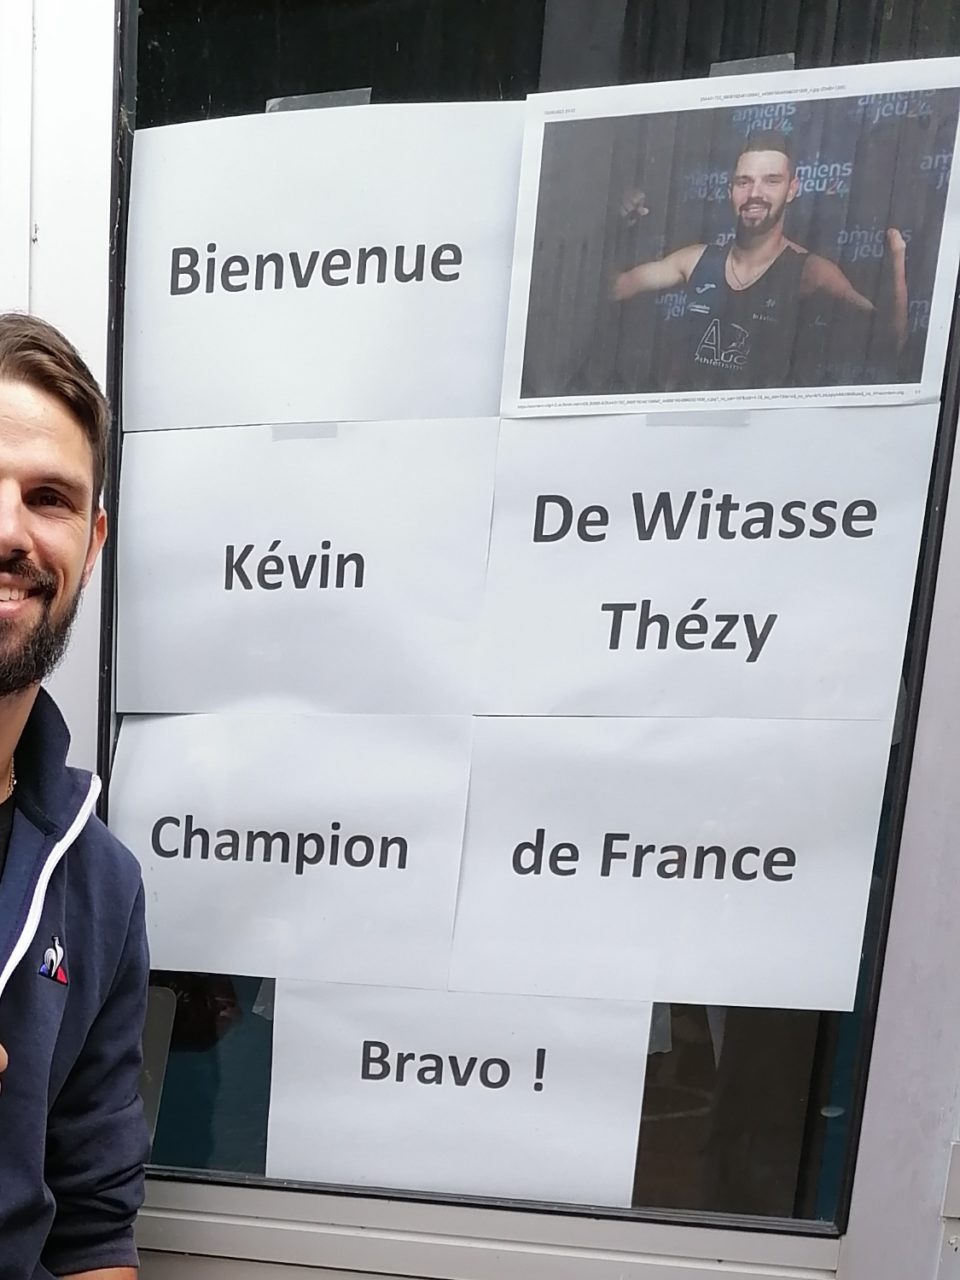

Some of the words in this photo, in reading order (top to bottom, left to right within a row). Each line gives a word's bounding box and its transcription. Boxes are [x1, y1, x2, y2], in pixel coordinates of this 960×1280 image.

[795, 158, 853, 178] miens
[170, 243, 462, 296] Bienvenue
[533, 494, 609, 543] De
[632, 488, 877, 541] Witasse
[224, 539, 365, 590] Kévin
[601, 598, 778, 663] Thézy
[151, 814, 408, 875] Champion
[512, 828, 579, 876] de
[600, 832, 796, 882] France
[361, 1040, 511, 1089] Bravo
[533, 1048, 546, 1092] !
